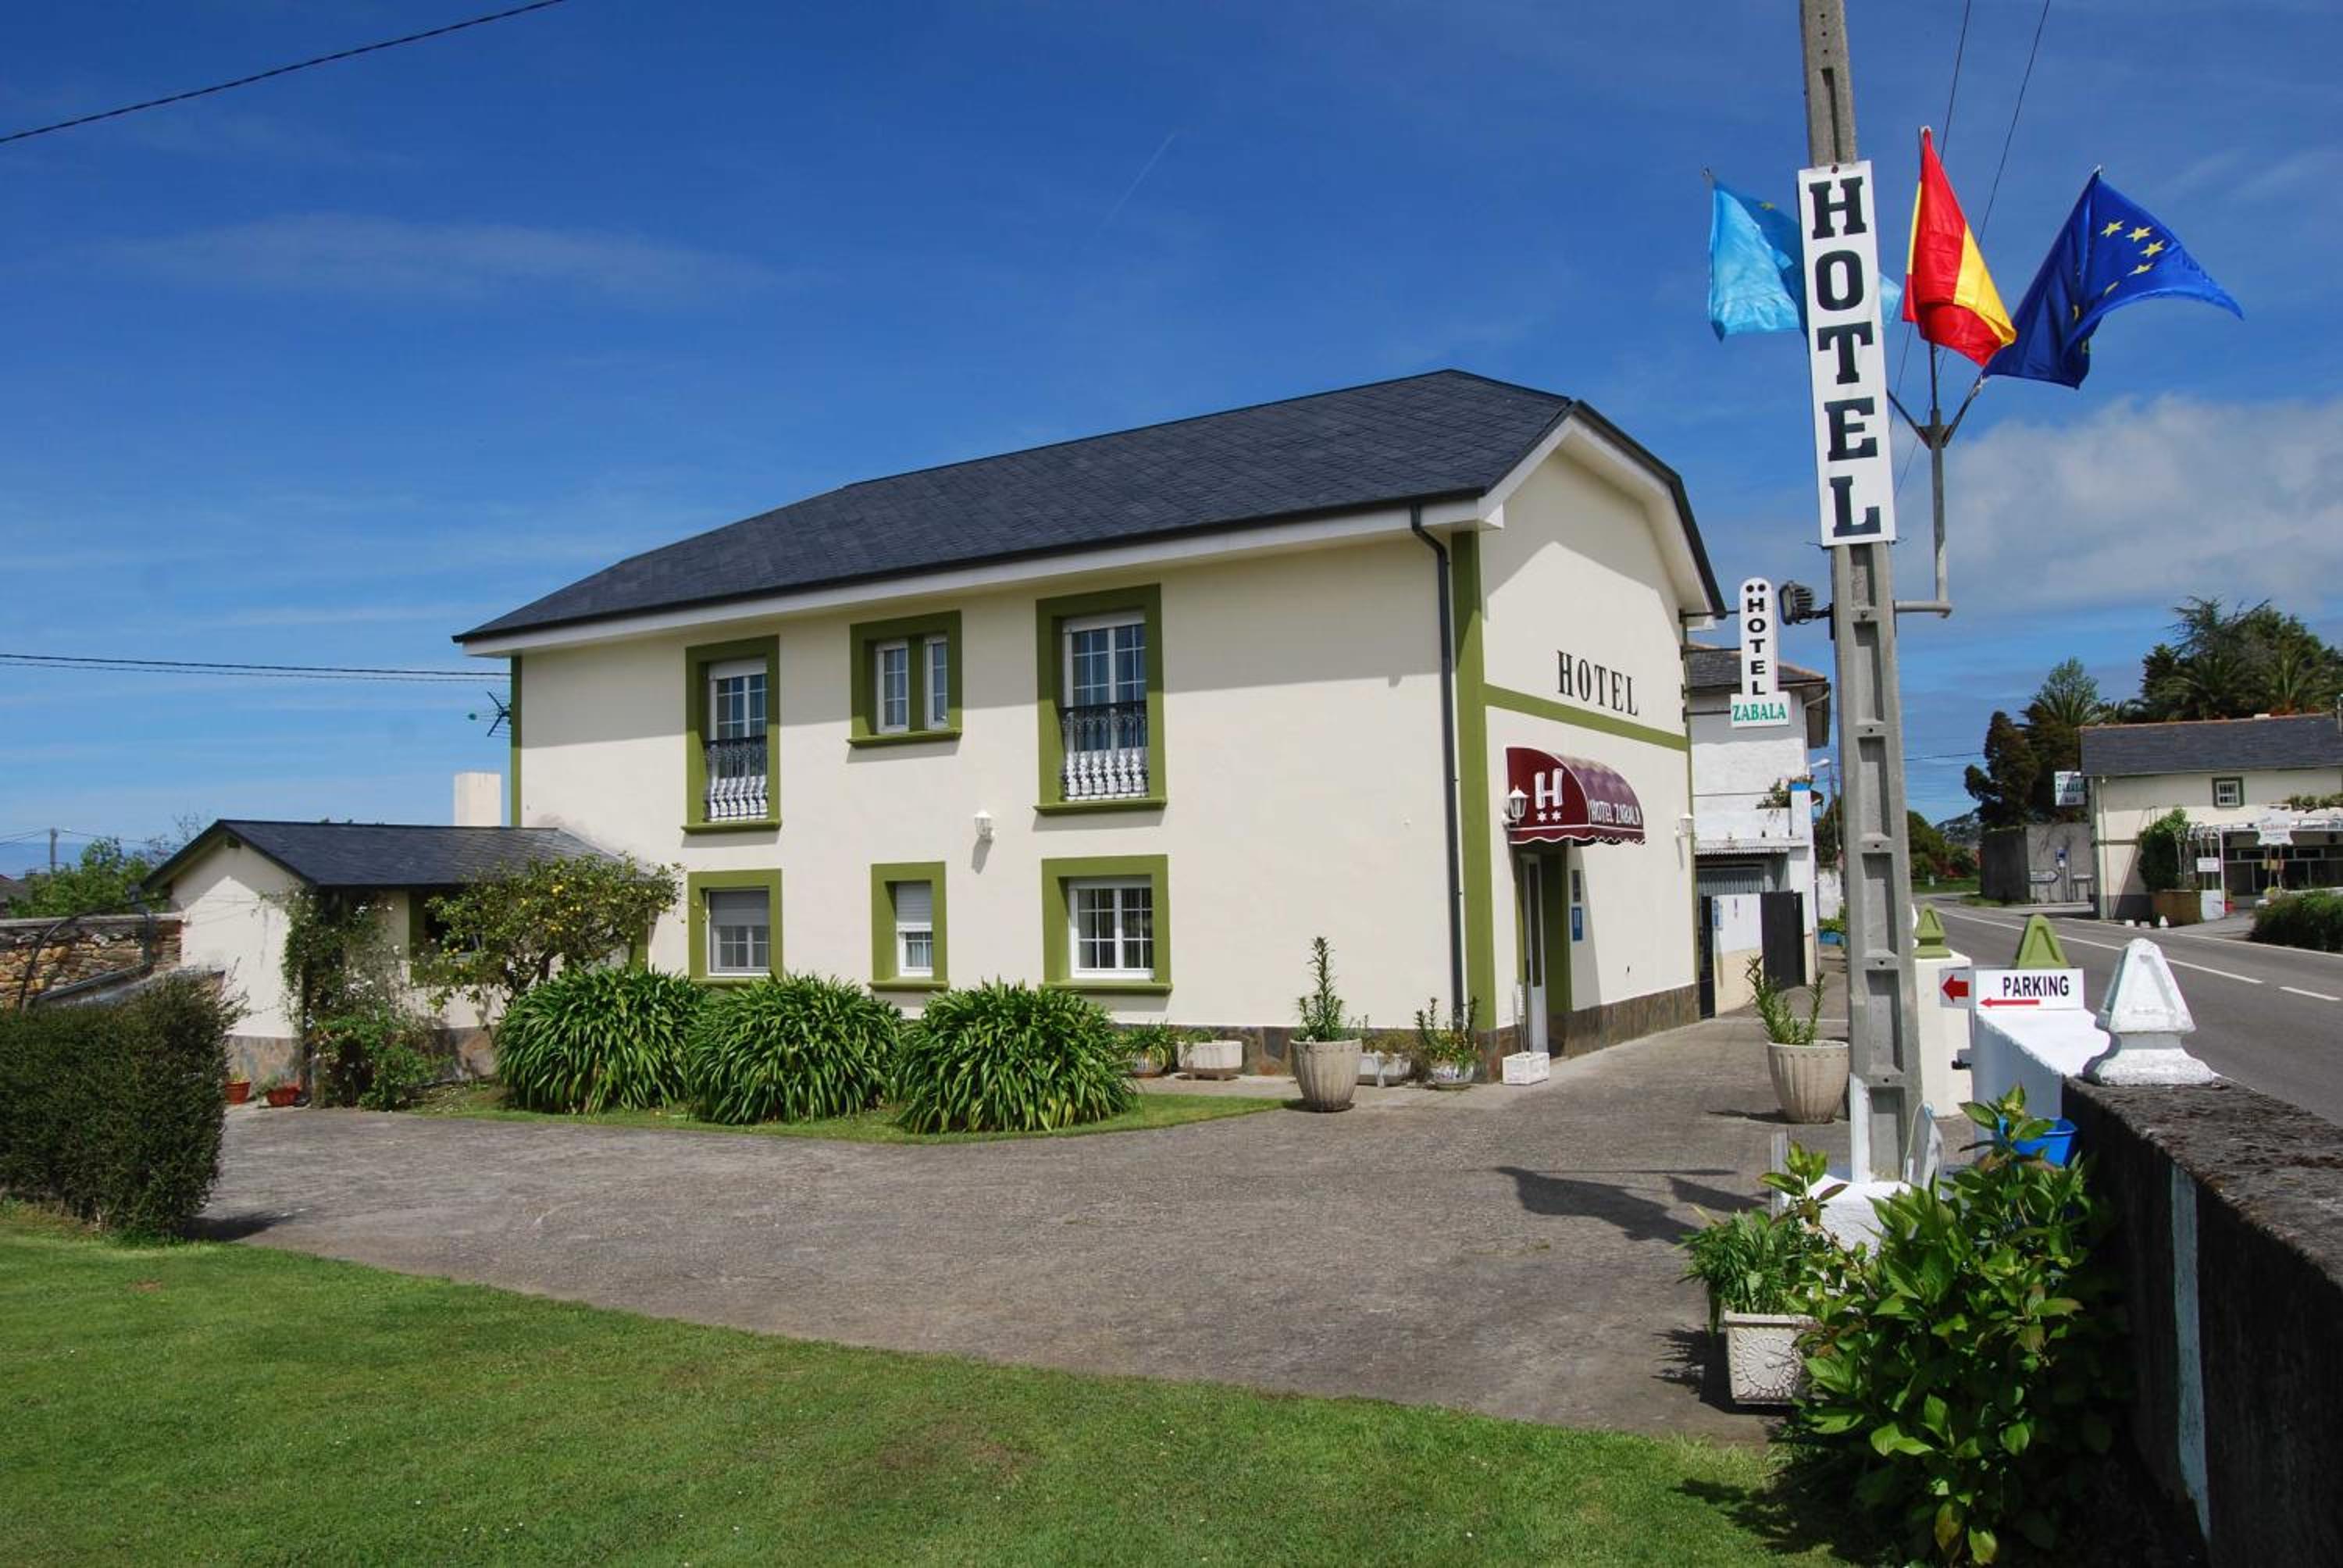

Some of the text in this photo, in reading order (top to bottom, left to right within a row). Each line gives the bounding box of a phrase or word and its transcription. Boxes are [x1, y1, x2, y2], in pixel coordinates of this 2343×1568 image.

[1808, 175, 1881, 538] HOTEL
[1747, 597, 1767, 696] HOTEL
[1557, 650, 1639, 717] HOTEL
[1731, 701, 1787, 722] ZABALA
[1534, 768, 1564, 810] H
[2002, 975, 2070, 998] PARKING
